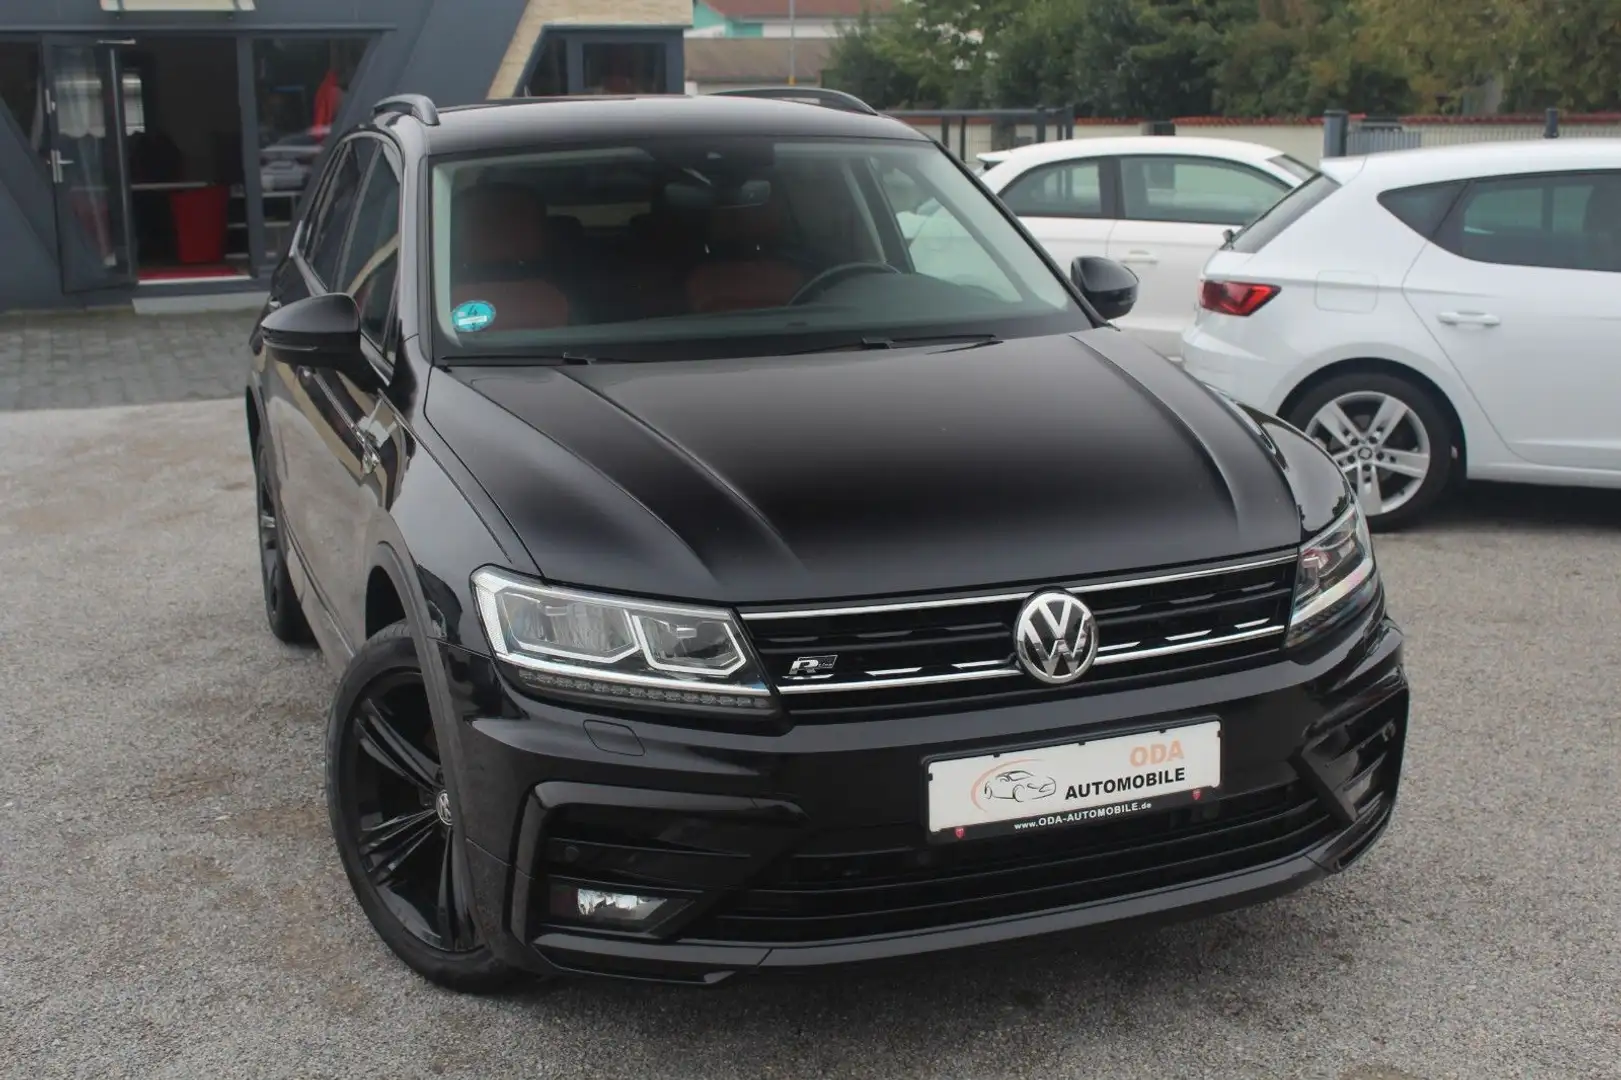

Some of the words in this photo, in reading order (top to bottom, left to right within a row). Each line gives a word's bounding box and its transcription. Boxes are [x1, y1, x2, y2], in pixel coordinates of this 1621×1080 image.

[1018, 593, 1098, 684] VW
[1130, 740, 1184, 767] ODA
[1065, 767, 1185, 800] AUTOMOBILE
[1014, 802, 1152, 830] www.ODA-AUTOMOBILE.de
